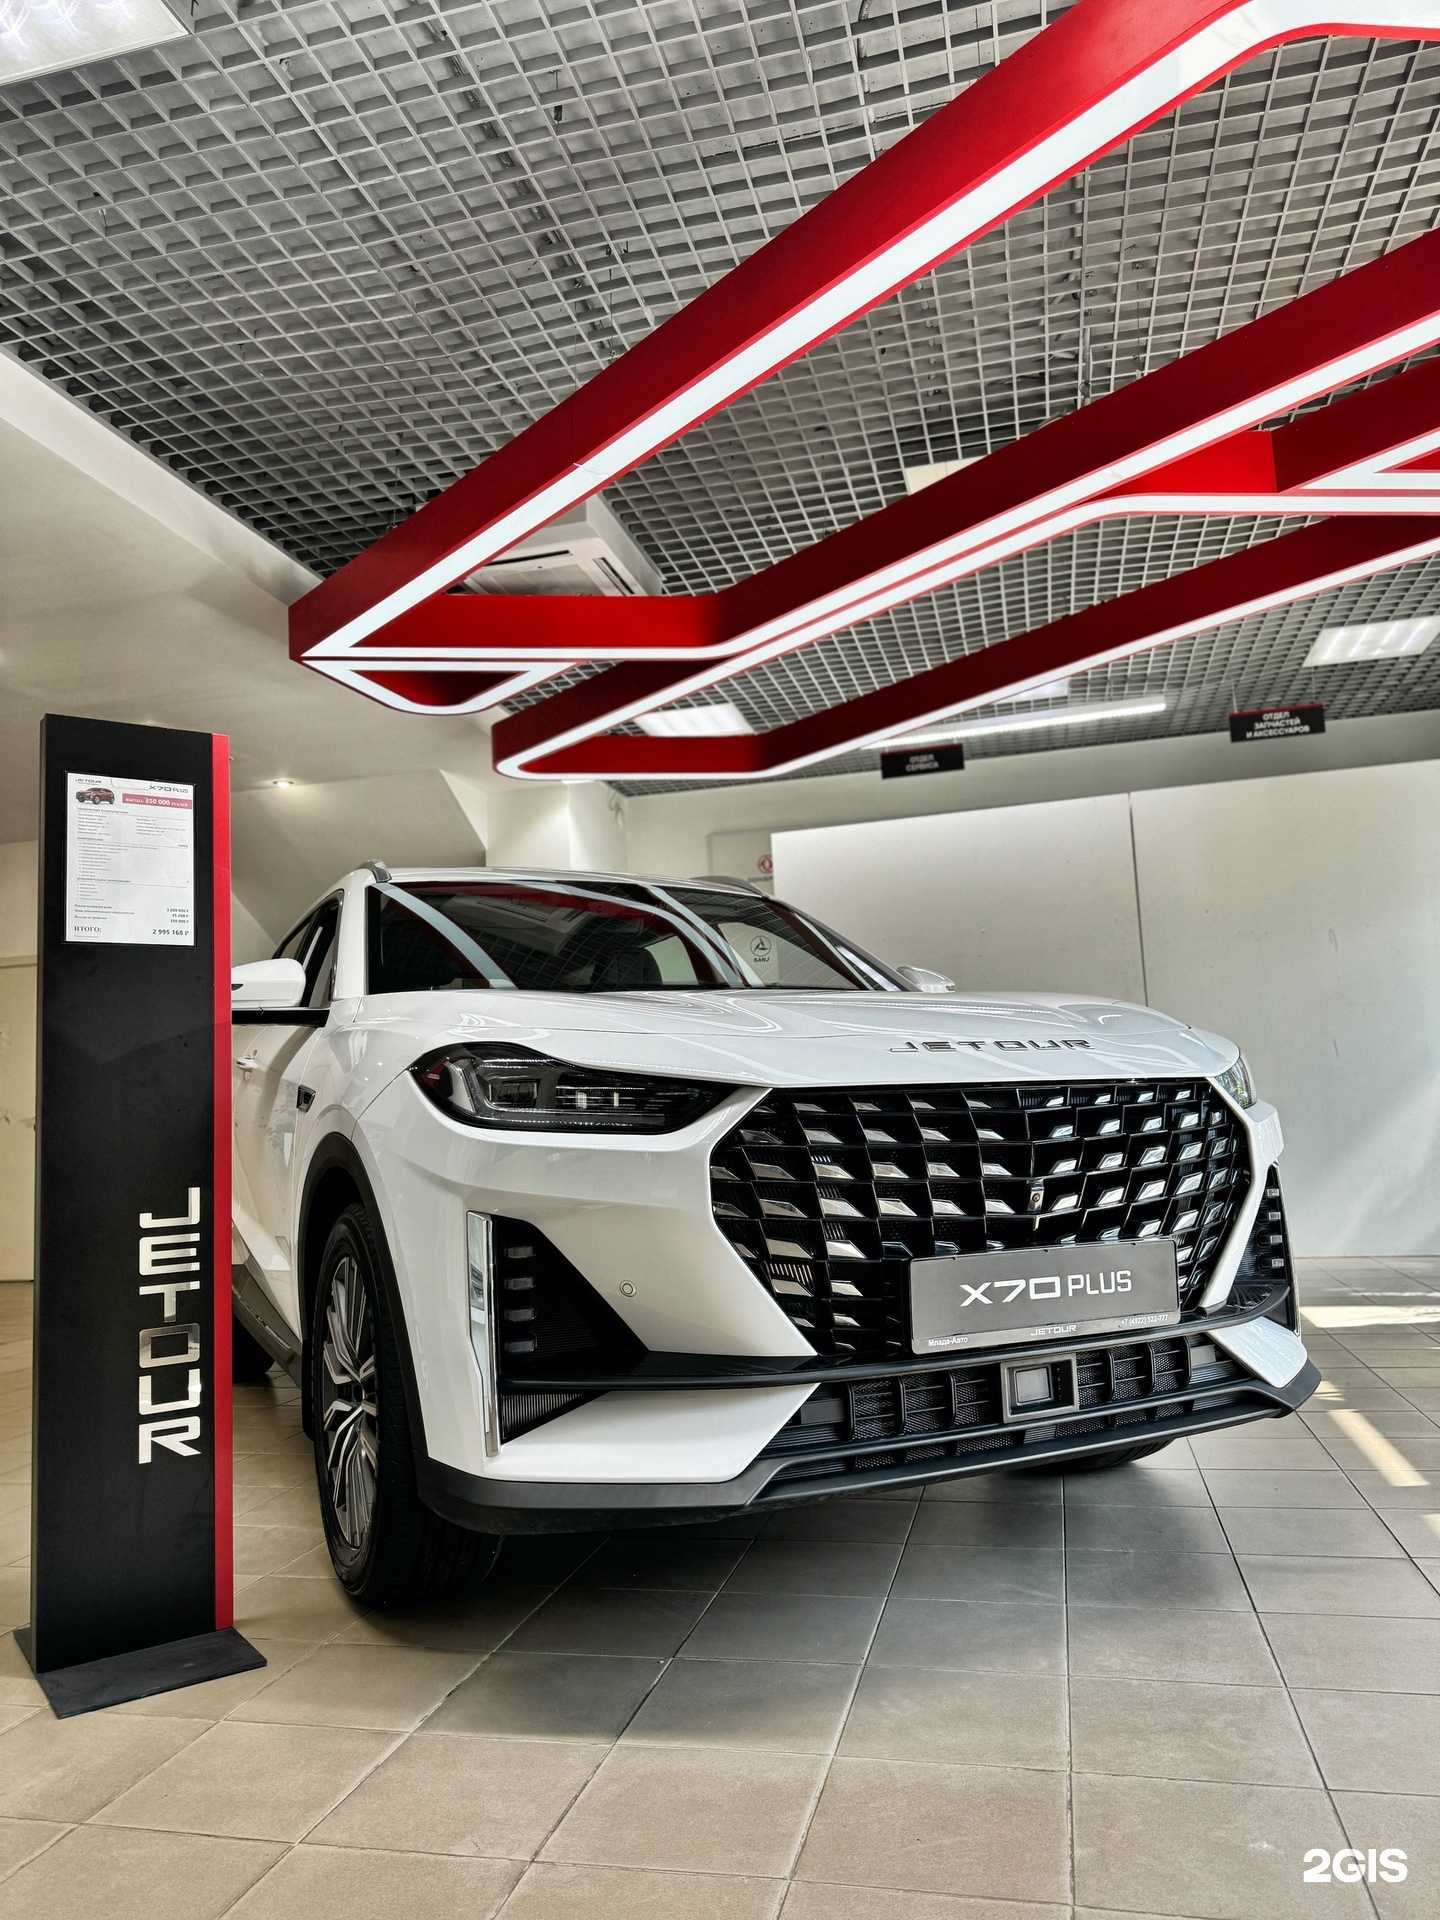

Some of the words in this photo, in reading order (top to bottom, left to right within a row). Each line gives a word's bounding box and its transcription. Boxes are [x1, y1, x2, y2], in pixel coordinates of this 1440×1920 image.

[1262, 711, 1290, 721] ОТДЕЛ
[1254, 717, 1301, 730] ЗАПЧАСТЕЙ
[1253, 725, 1310, 738] АКСЕССУАРОВ
[889, 1039, 1095, 1052] JETOUR
[959, 1276, 1061, 1308] X70
[1067, 1270, 1132, 1298] PLUS
[139, 1186, 202, 1465] JETOUR
[1029, 1324, 1077, 1337] JETOUR
